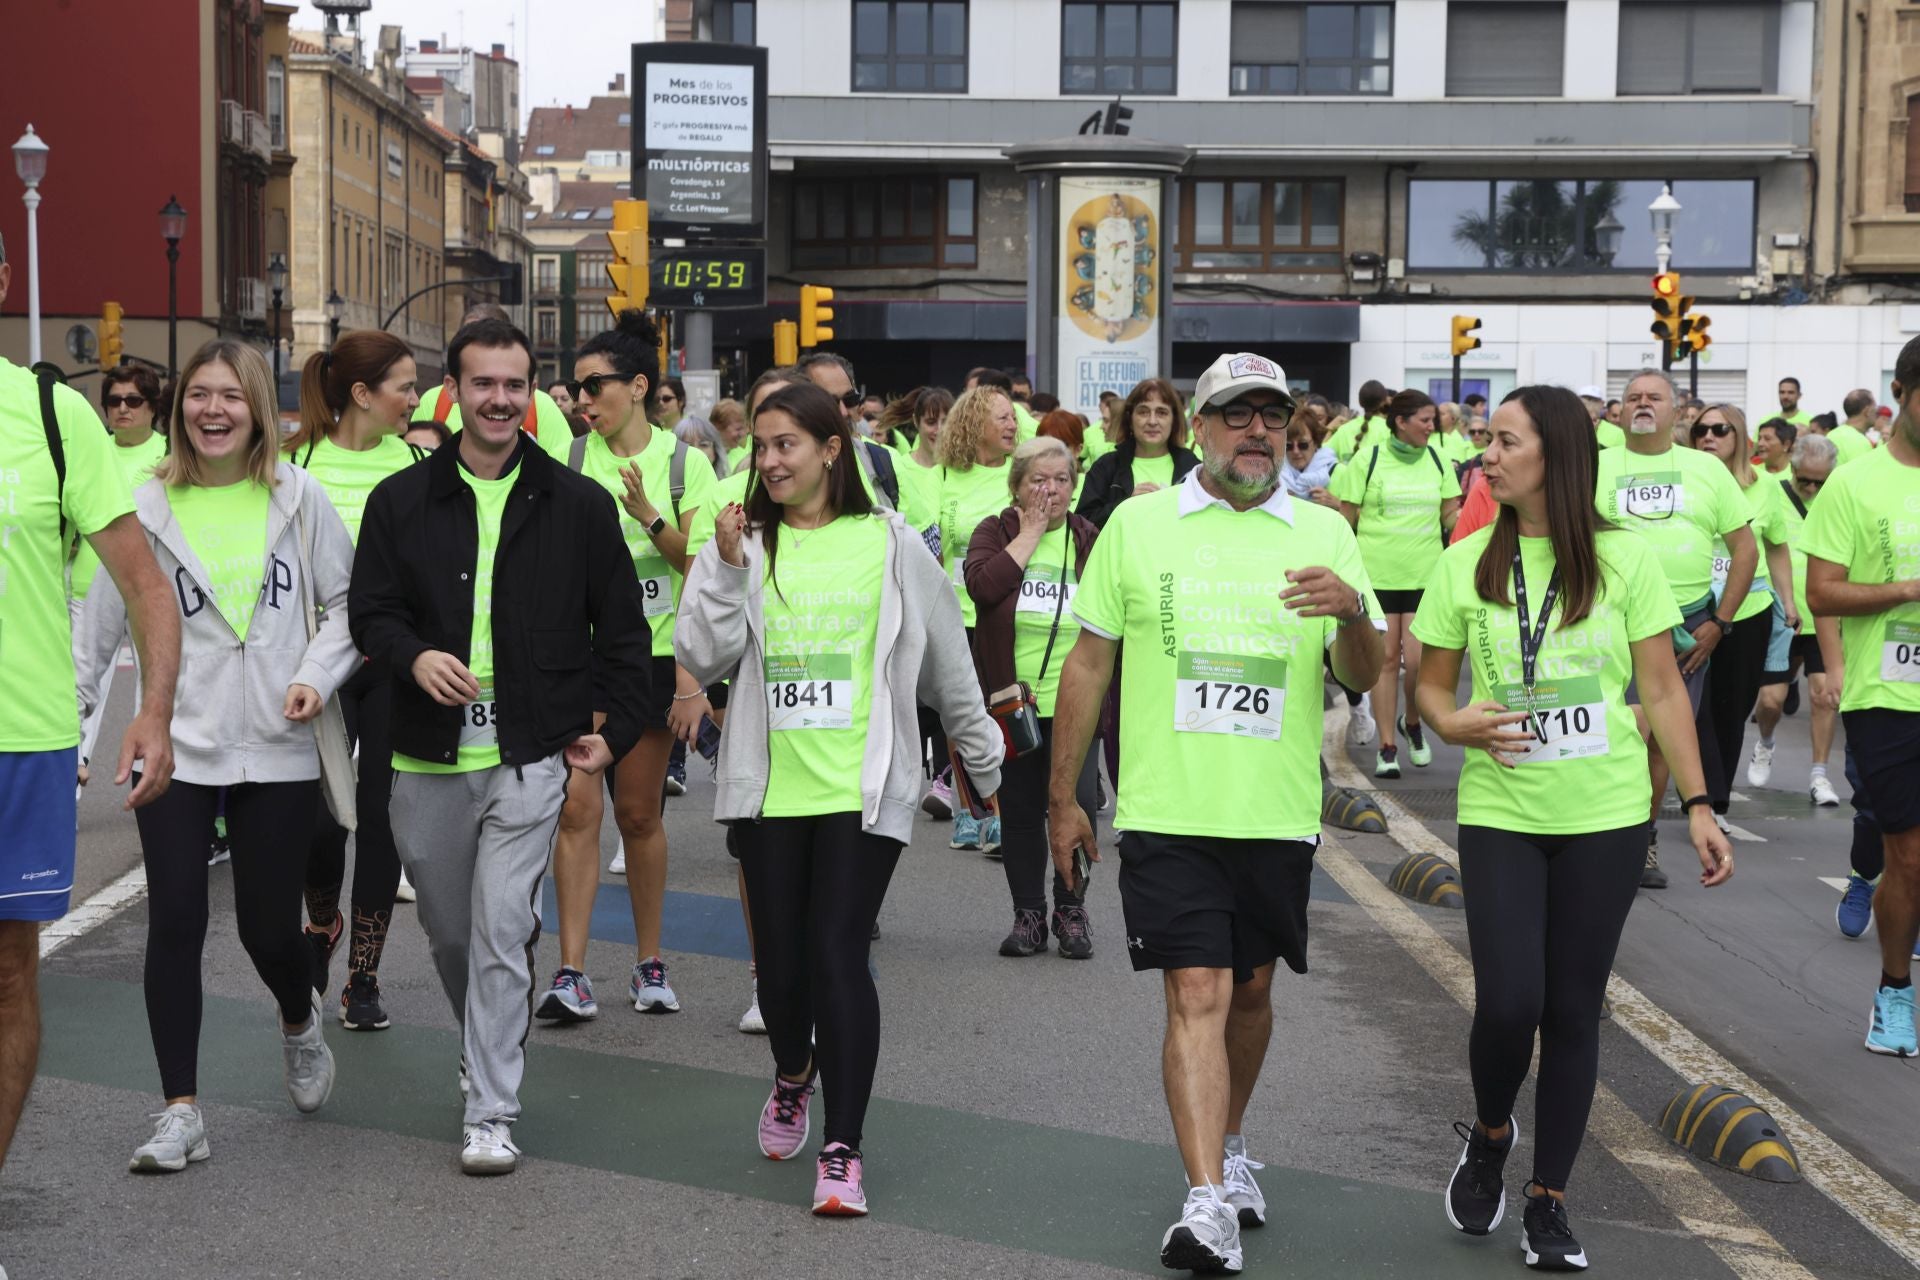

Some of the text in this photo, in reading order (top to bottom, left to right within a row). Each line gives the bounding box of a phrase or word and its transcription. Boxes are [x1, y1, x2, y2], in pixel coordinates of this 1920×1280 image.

[669, 79, 733, 90] Mes de los
[653, 94, 748, 106] PROGRESIVOS
[680, 122, 733, 130] PROGRESIVA
[670, 177, 713, 188] Covadonga,
[670, 190, 709, 200] Argentina,
[670, 204, 684, 212] C.C.
[686, 204, 699, 212] Los
[663, 261, 745, 288] 10:59
[1080, 361, 1146, 381] EL REFUGIO
[1629, 485, 1672, 502] 1697
[1181, 578, 1211, 595] En
[793, 587, 872, 607] marcha
[765, 607, 840, 631] contra
[1160, 572, 1177, 659] ASTURIAS
[1180, 602, 1272, 624] contra
[1183, 626, 1303, 656] cáncer
[1477, 607, 1500, 690] ASTURIAS
[773, 682, 832, 708] 1841
[1195, 682, 1270, 714] 1726
